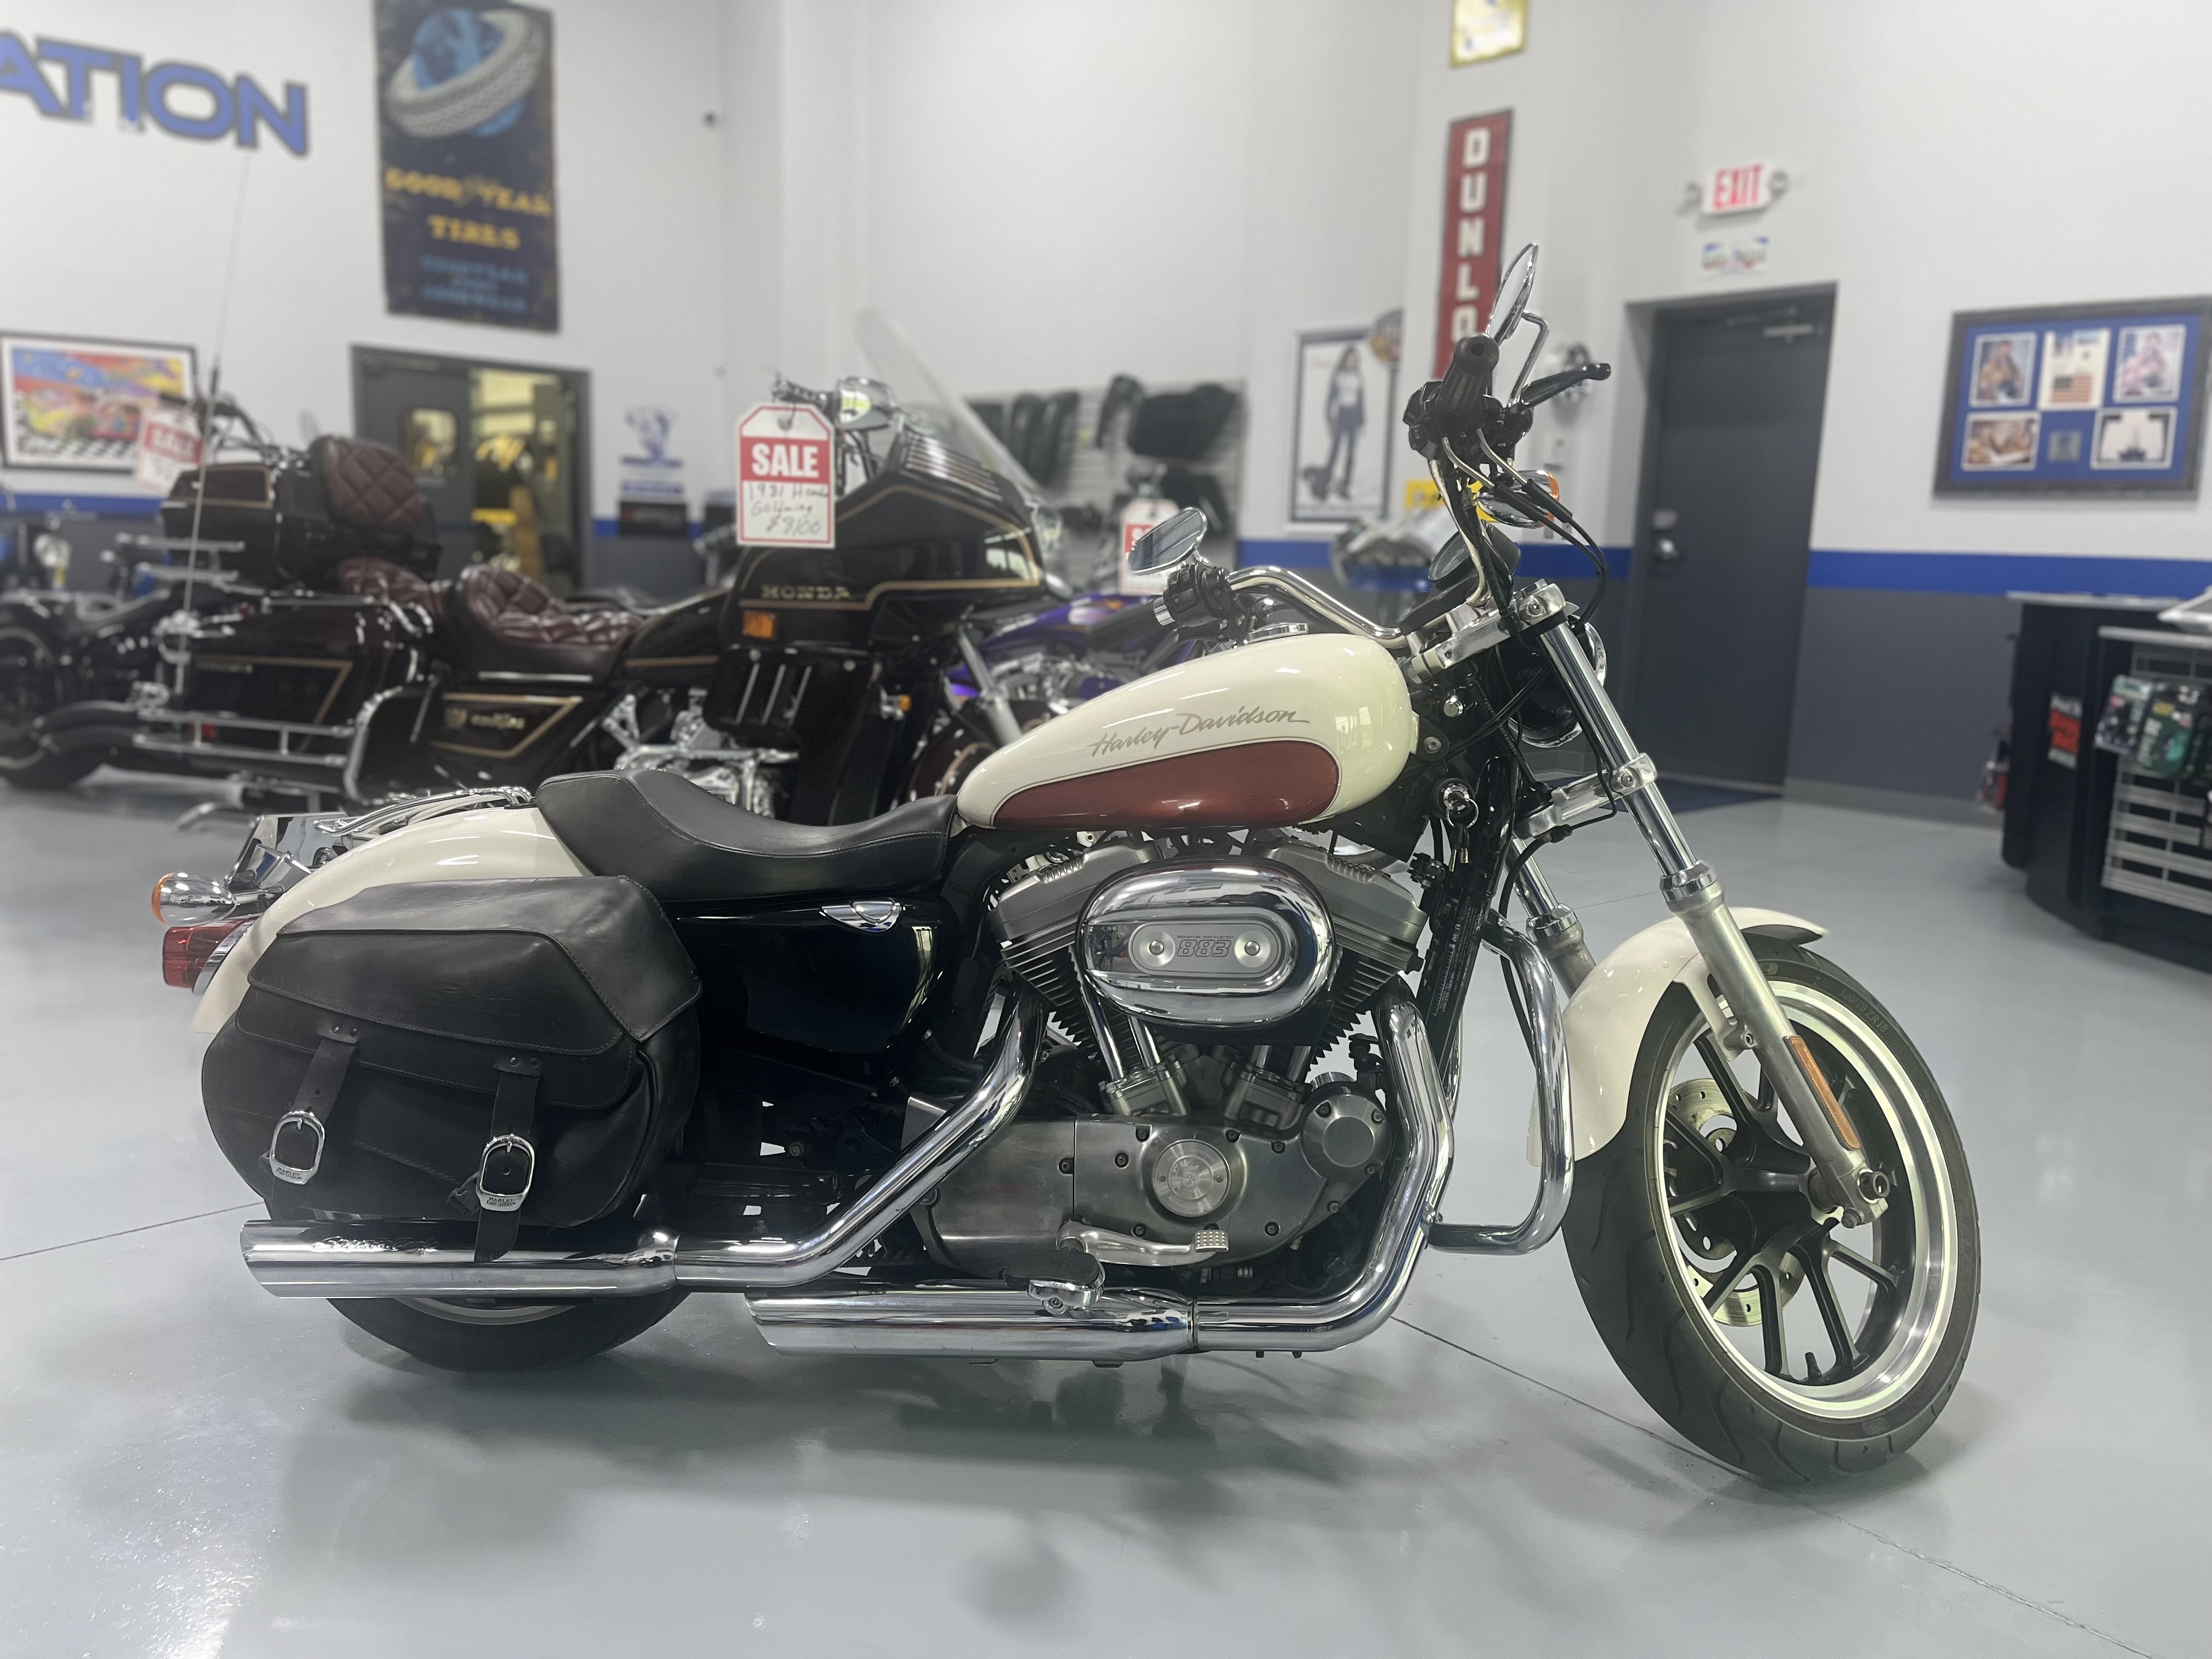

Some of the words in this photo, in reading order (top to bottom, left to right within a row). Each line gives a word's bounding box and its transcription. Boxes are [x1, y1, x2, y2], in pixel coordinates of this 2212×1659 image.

[1712, 163, 1764, 211] EXIT
[426, 214, 521, 251] TIRES
[1449, 126, 1492, 350] DUNLO
[751, 442, 820, 479] SALE
[760, 585, 853, 600] HONDA
[1087, 706, 1310, 758] Harley-Davidson
[1177, 939, 1232, 957] 883
